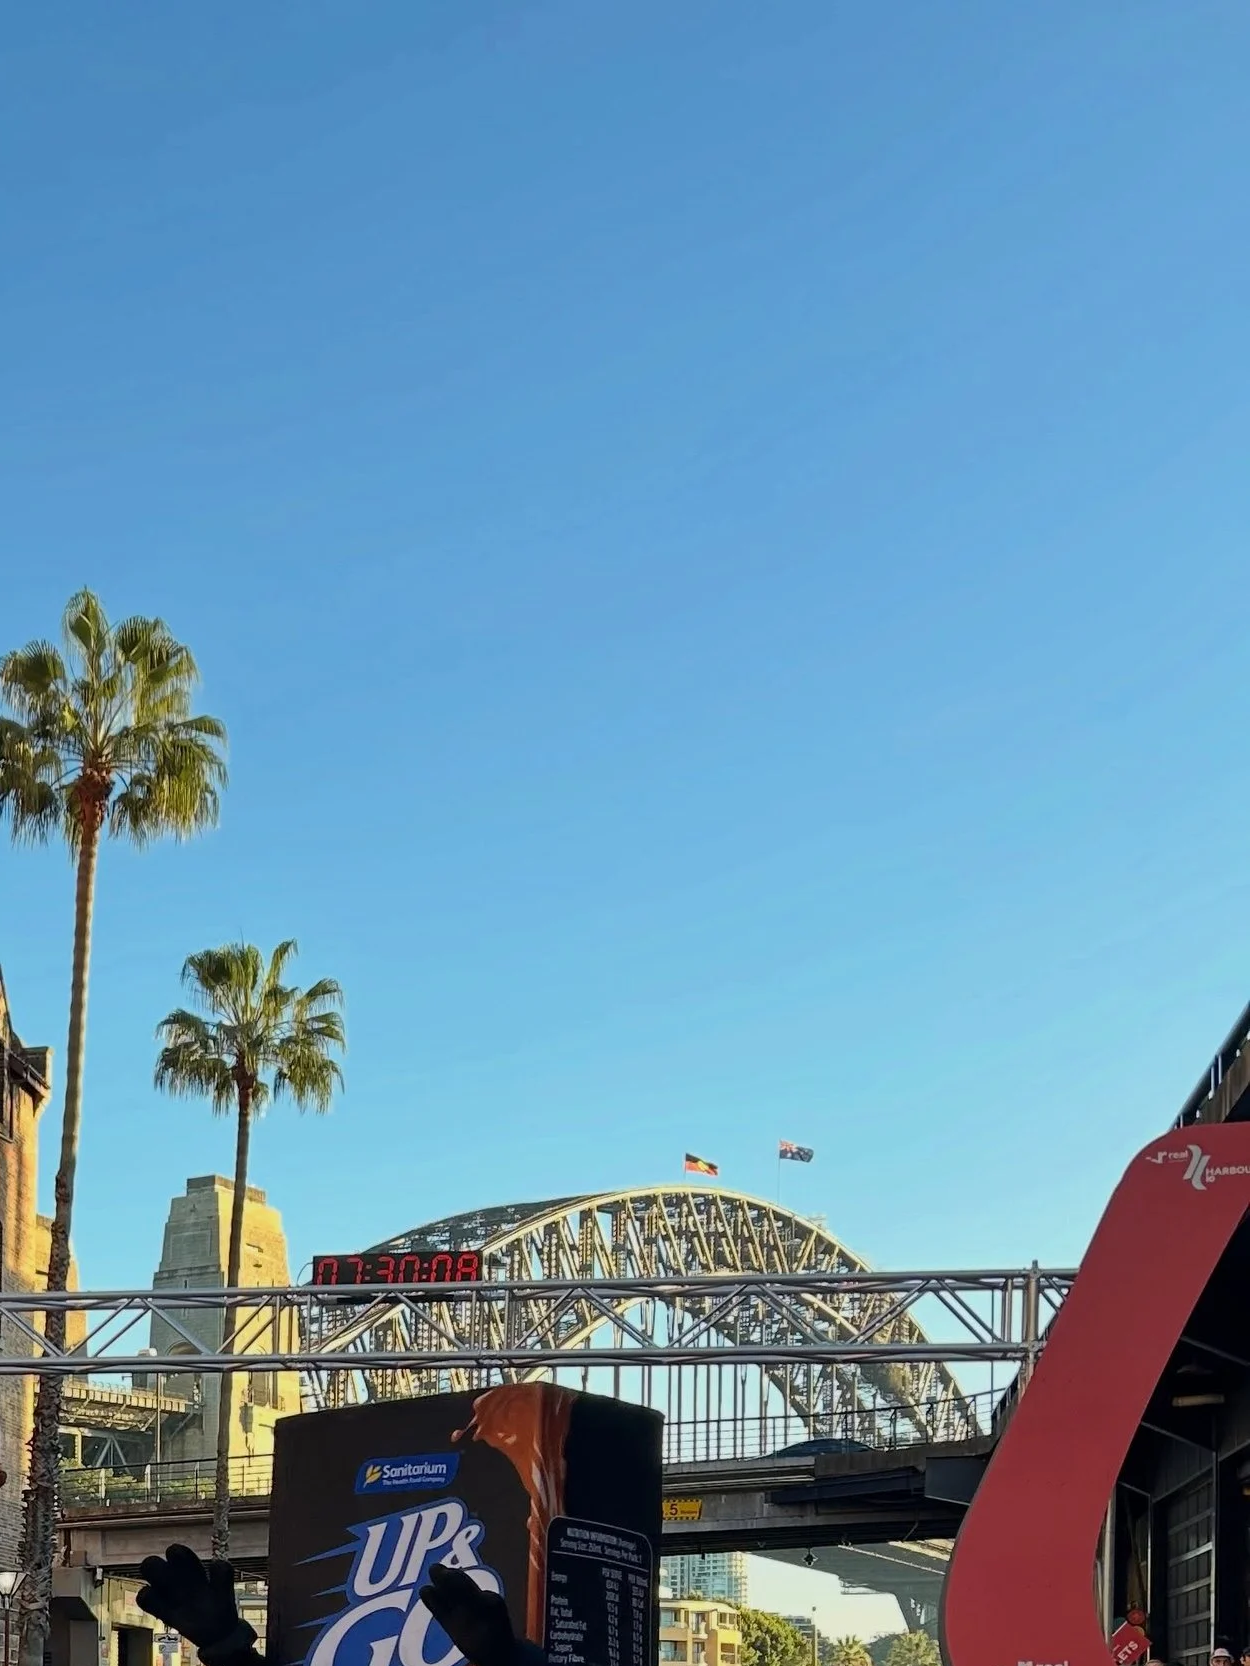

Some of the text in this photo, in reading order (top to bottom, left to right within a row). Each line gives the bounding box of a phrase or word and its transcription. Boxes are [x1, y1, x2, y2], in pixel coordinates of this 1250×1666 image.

[1168, 1150, 1188, 1159] real
[317, 1253, 479, 1285] 07:30:08
[381, 1461, 447, 1479] Sanitarium
[1117, 1641, 1138, 1664] ETS
